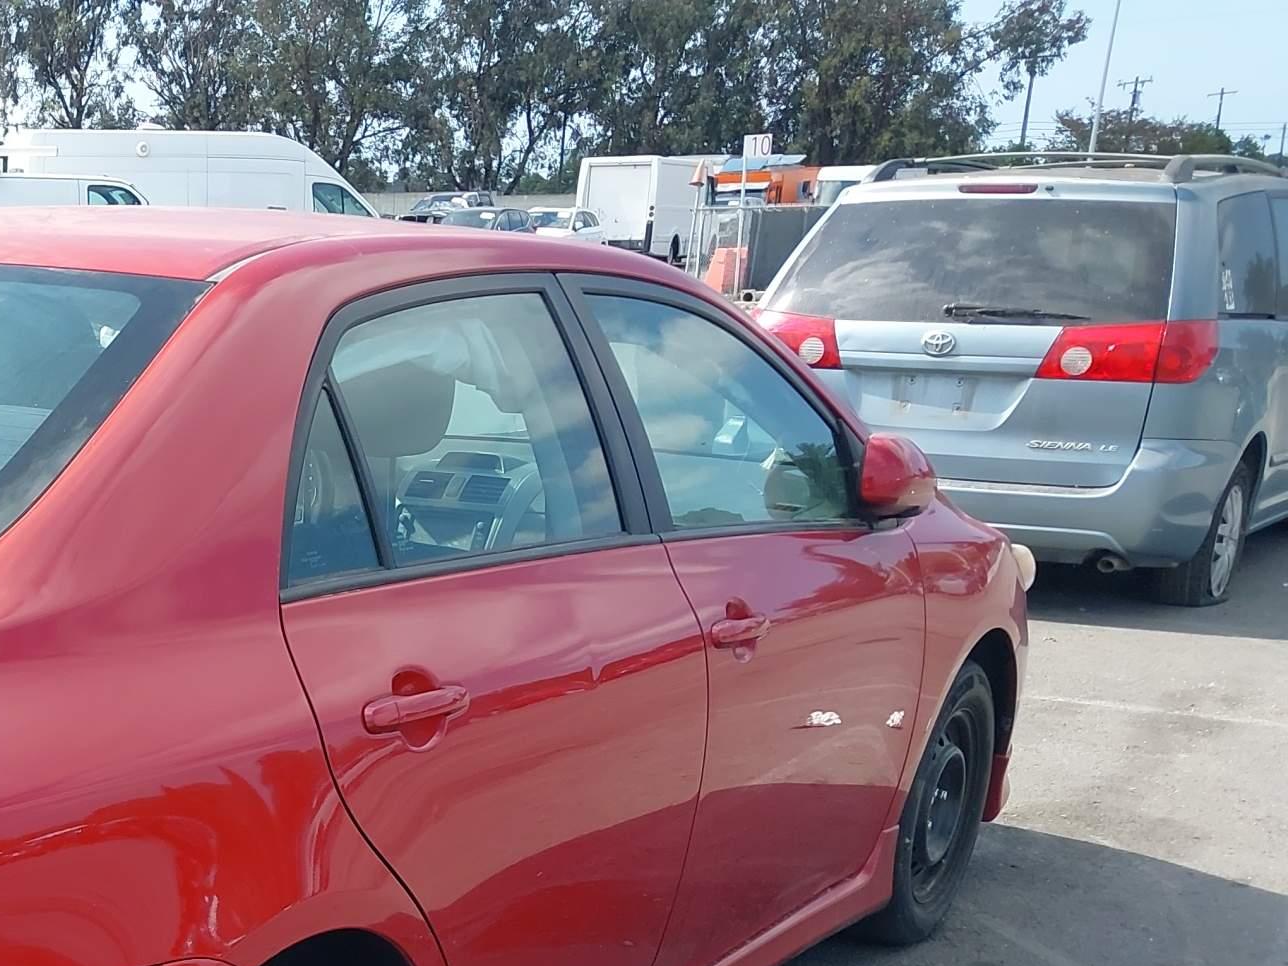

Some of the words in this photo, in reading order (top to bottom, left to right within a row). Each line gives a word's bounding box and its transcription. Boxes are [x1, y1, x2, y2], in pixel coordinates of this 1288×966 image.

[752, 135, 771, 156] 10
[1026, 440, 1092, 451] SIENNA
[1099, 444, 1119, 452] LE
